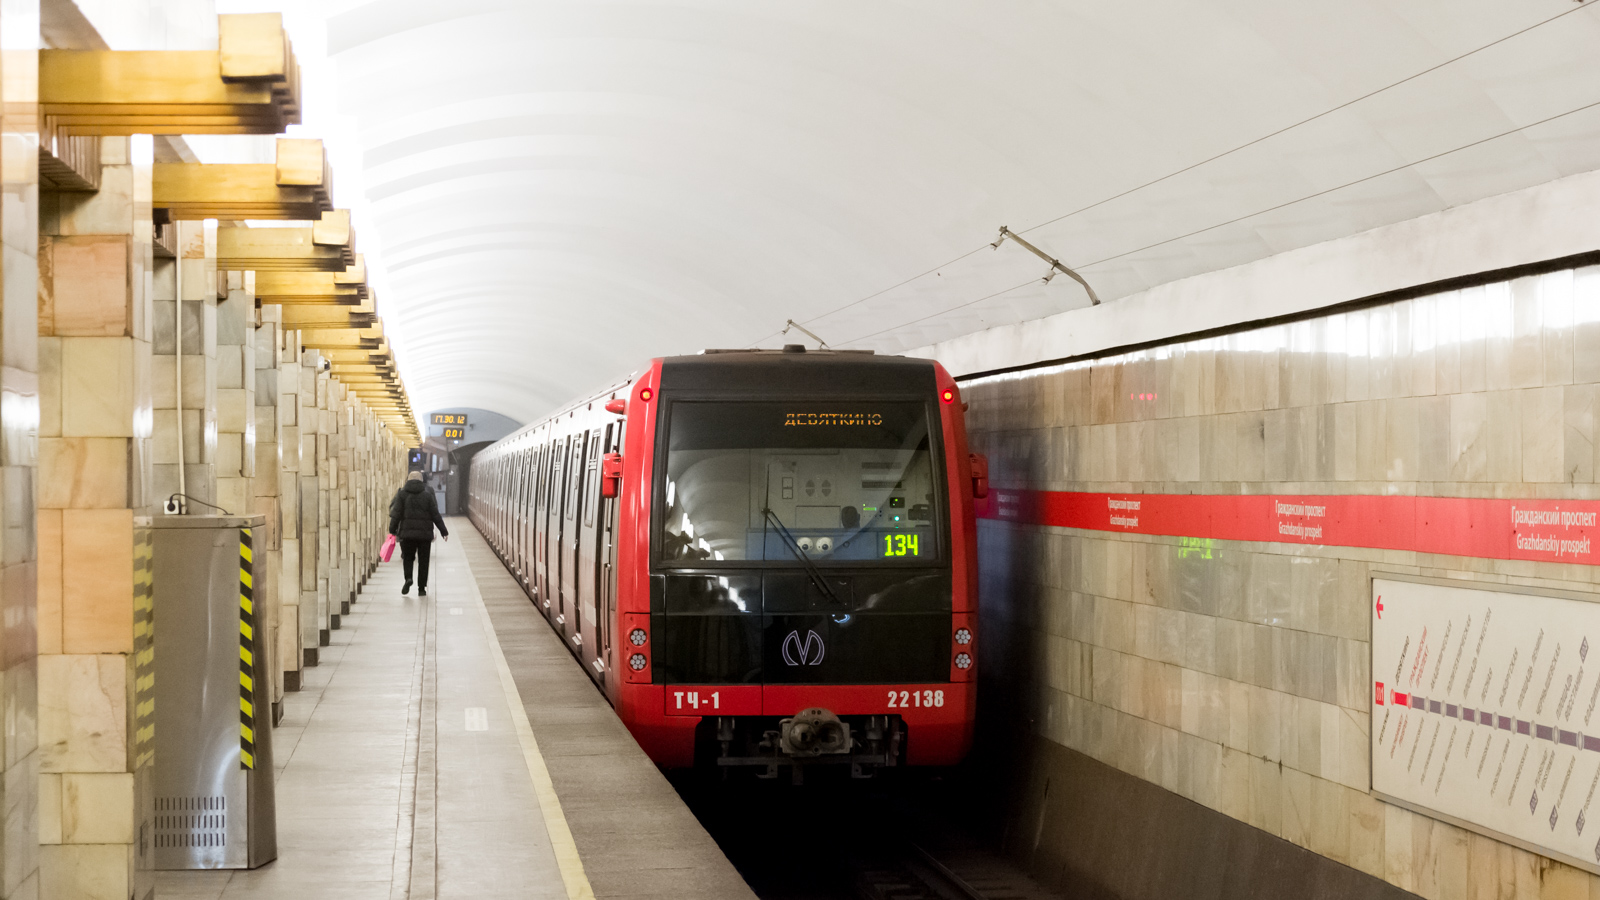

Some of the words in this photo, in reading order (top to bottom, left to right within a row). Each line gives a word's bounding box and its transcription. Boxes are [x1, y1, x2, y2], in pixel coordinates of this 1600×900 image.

[784, 413, 882, 426] ДЕВЯТКИНО
[1511, 506, 1560, 528] Гражданский
[1561, 511, 1597, 531] проспект
[884, 534, 919, 556] 134
[1516, 533, 1560, 557] Grazhdanskiy
[1560, 535, 1591, 557] prospekt
[673, 691, 720, 709] ТЧ-1
[887, 690, 945, 708] 22138
